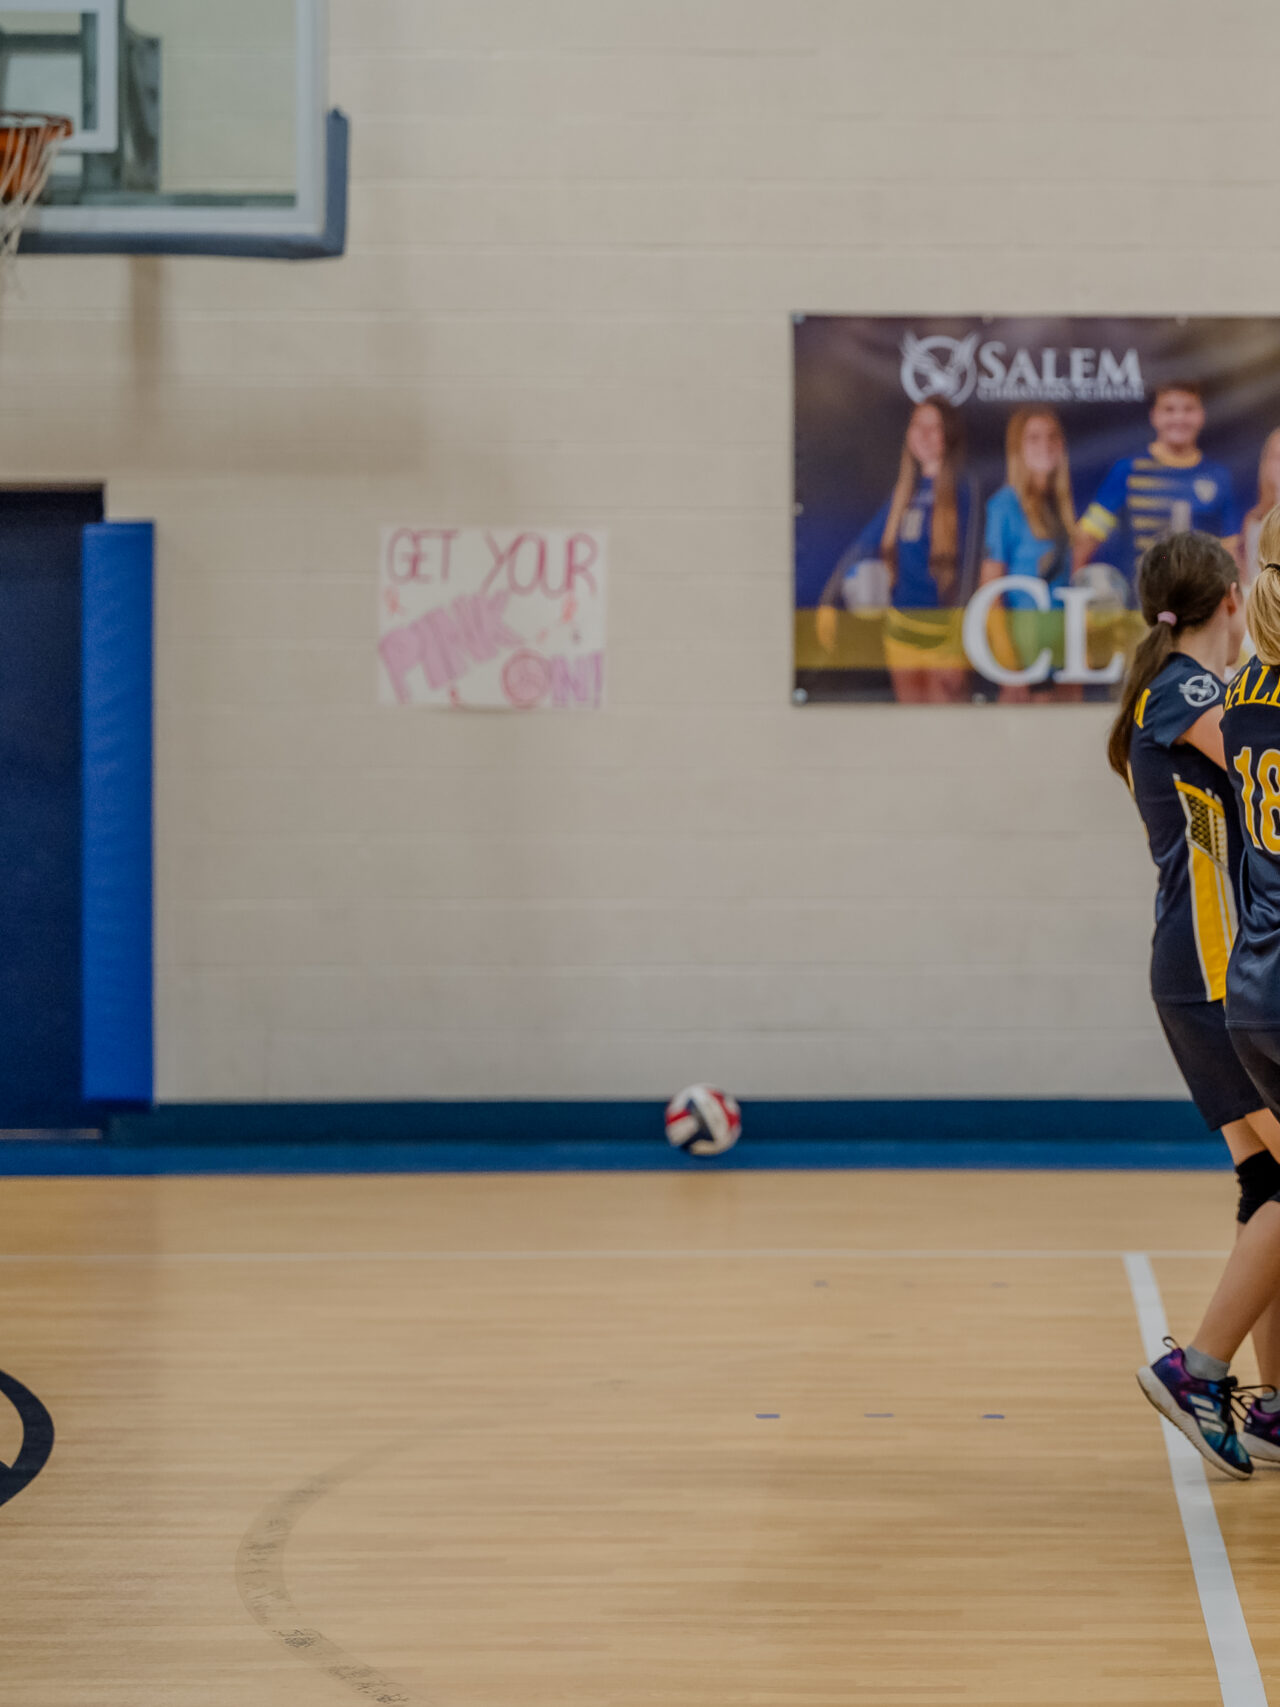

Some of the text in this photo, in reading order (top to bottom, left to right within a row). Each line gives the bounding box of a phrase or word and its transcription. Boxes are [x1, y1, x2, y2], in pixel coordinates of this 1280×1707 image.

[979, 341, 1143, 386] SALEM
[386, 528, 599, 598] GET YOUR
[379, 588, 526, 705] PINK
